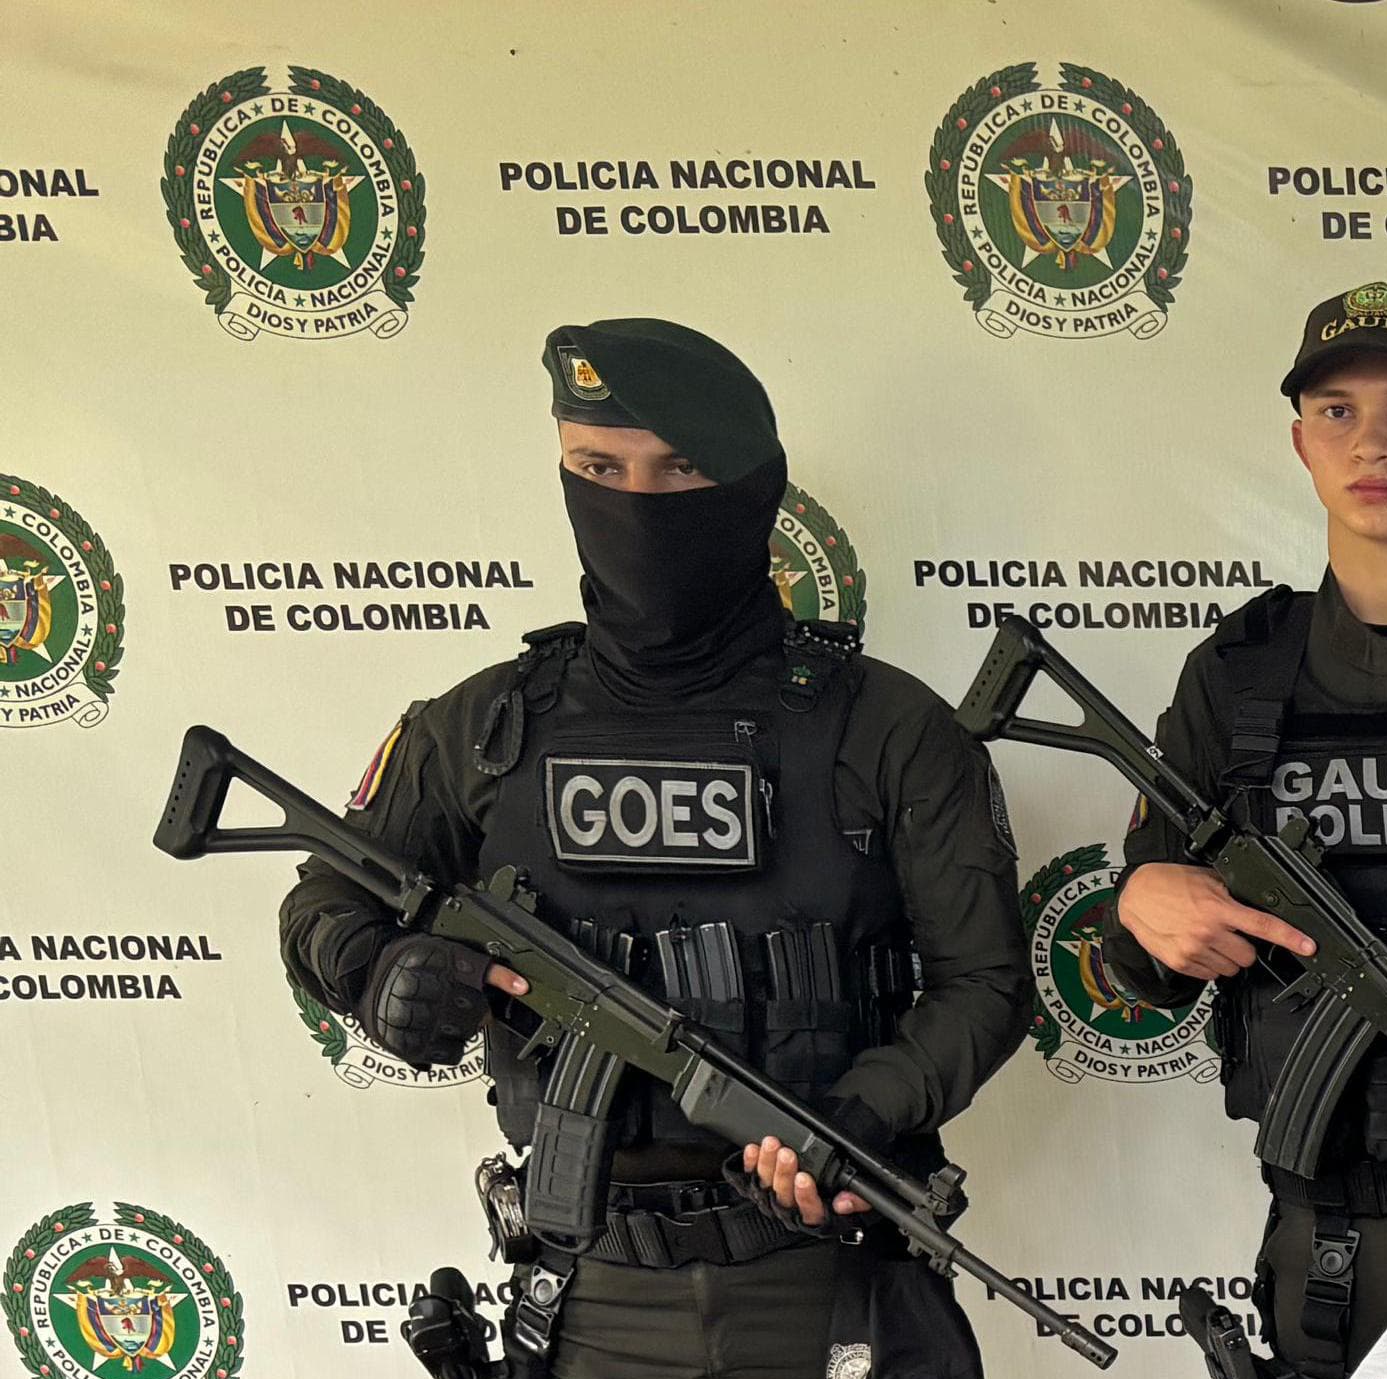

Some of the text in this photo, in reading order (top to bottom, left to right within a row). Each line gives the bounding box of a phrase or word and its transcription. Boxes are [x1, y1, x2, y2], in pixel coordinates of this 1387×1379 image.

[271, 98, 298, 113] DE
[322, 109, 394, 217] COLOMBIA
[1041, 95, 1068, 110] DE
[1091, 108, 1160, 217] COLOMBIA
[500, 160, 875, 190] POLICIA NACIONAL
[556, 205, 830, 234] DE COLOMBIA
[1322, 212, 1372, 239] DE
[310, 242, 391, 307] NACIONAL
[1071, 243, 1155, 307] NACIONAL
[314, 302, 378, 332] PATRIA
[1073, 303, 1138, 332] PATRIA
[169, 561, 533, 590] POLICIA NACIONAL
[914, 560, 1274, 589] POLICIA NACIONAL
[225, 604, 490, 631] DE COLOMBIA
[1028, 603, 1225, 630] COLOMBIA
[561, 774, 743, 850] GOES
[32, 936, 222, 960] NACIONAL
[1137, 1052, 1198, 1077] PATRIA
[100, 1229, 125, 1241] DE
[146, 1238, 215, 1328] COLOMBIA
[341, 1321, 388, 1343] DE
